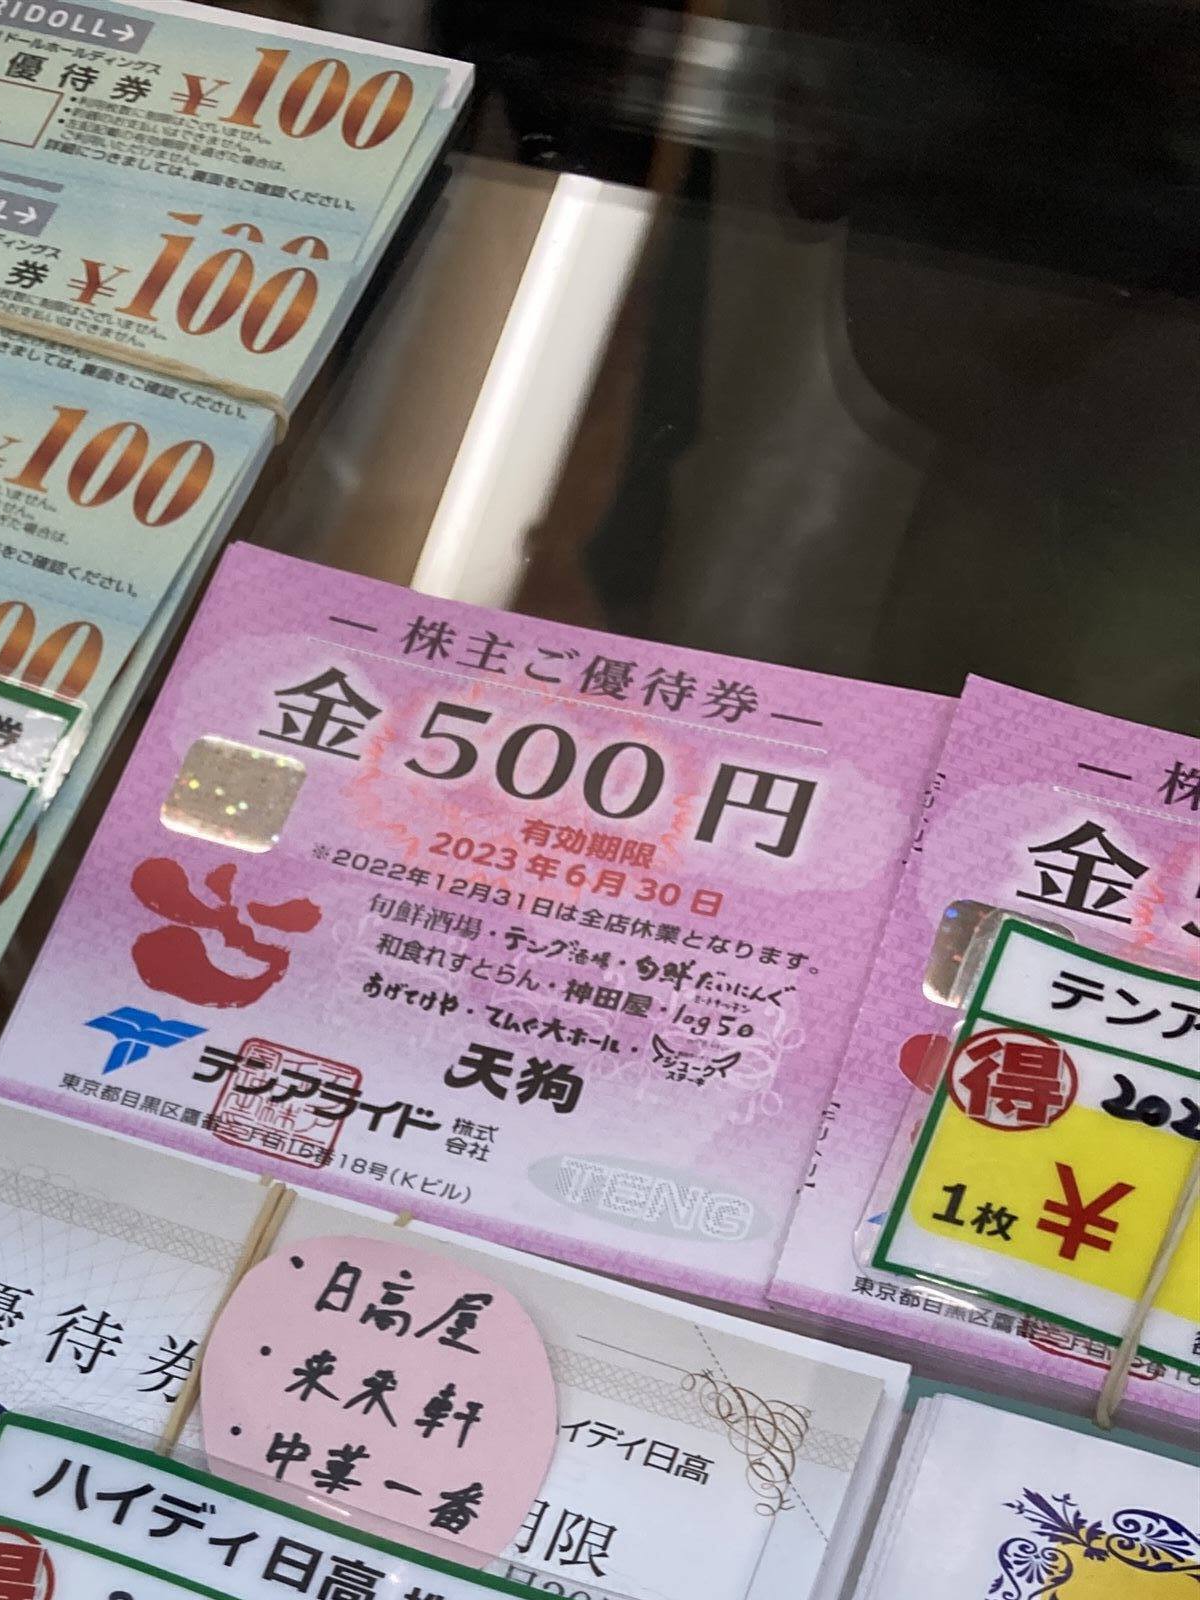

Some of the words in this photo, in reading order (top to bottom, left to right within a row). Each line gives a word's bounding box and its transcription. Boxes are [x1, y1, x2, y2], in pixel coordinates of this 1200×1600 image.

[170, 46, 415, 150] ¥100
[399, 612, 761, 726] 株主ご優待券
[518, 816, 659, 873] 有効期限
[1015, 819, 1151, 926] 金
[310, 840, 823, 977] ※2022年12月31日は全店休業となります。
[191, 1044, 443, 1140] テンアライド
[443, 1041, 586, 1116] 天狗
[953, 1033, 1072, 1128] 得
[443, 1136, 491, 1164] 会社
[932, 1181, 1019, 1245] 1枚
[560, 1417, 717, 1487] イディ日高
